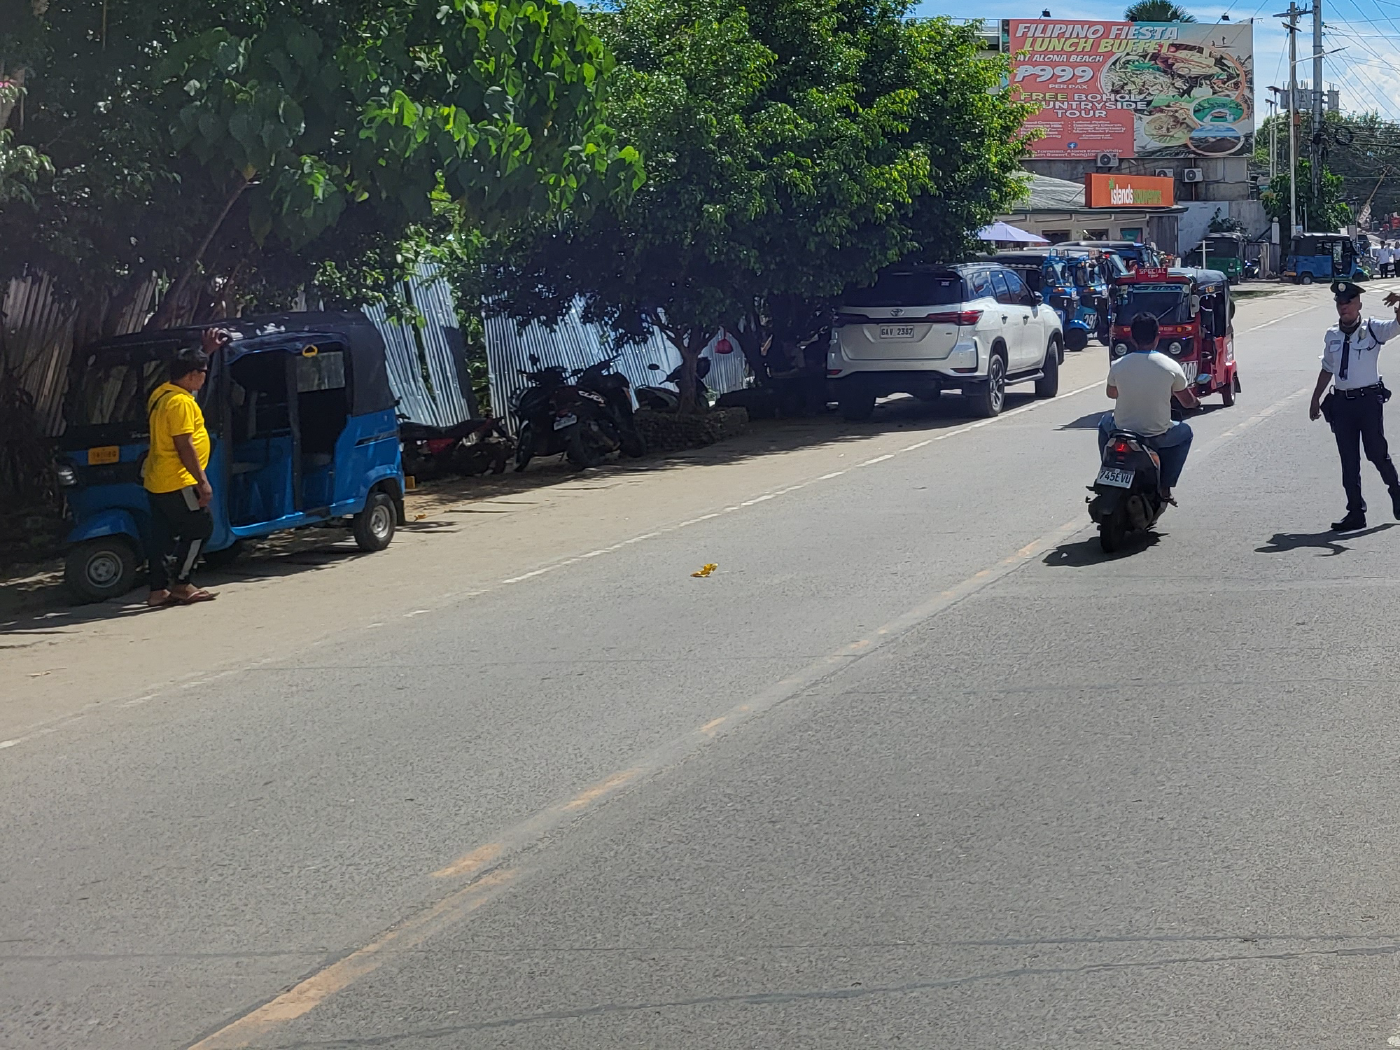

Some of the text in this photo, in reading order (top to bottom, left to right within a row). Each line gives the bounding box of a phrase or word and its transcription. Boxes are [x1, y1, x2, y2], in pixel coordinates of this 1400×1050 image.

[1015, 23, 1179, 40] FILIPINO FIESTA
[1023, 37, 1171, 54] LUNCH BUFFET
[1016, 54, 1104, 63] AT ALONA BEACH
[1020, 92, 1141, 101] FREE BOHOL
[1017, 101, 1148, 110] UNTRYSIDE
[1053, 109, 1107, 118] TOUR
